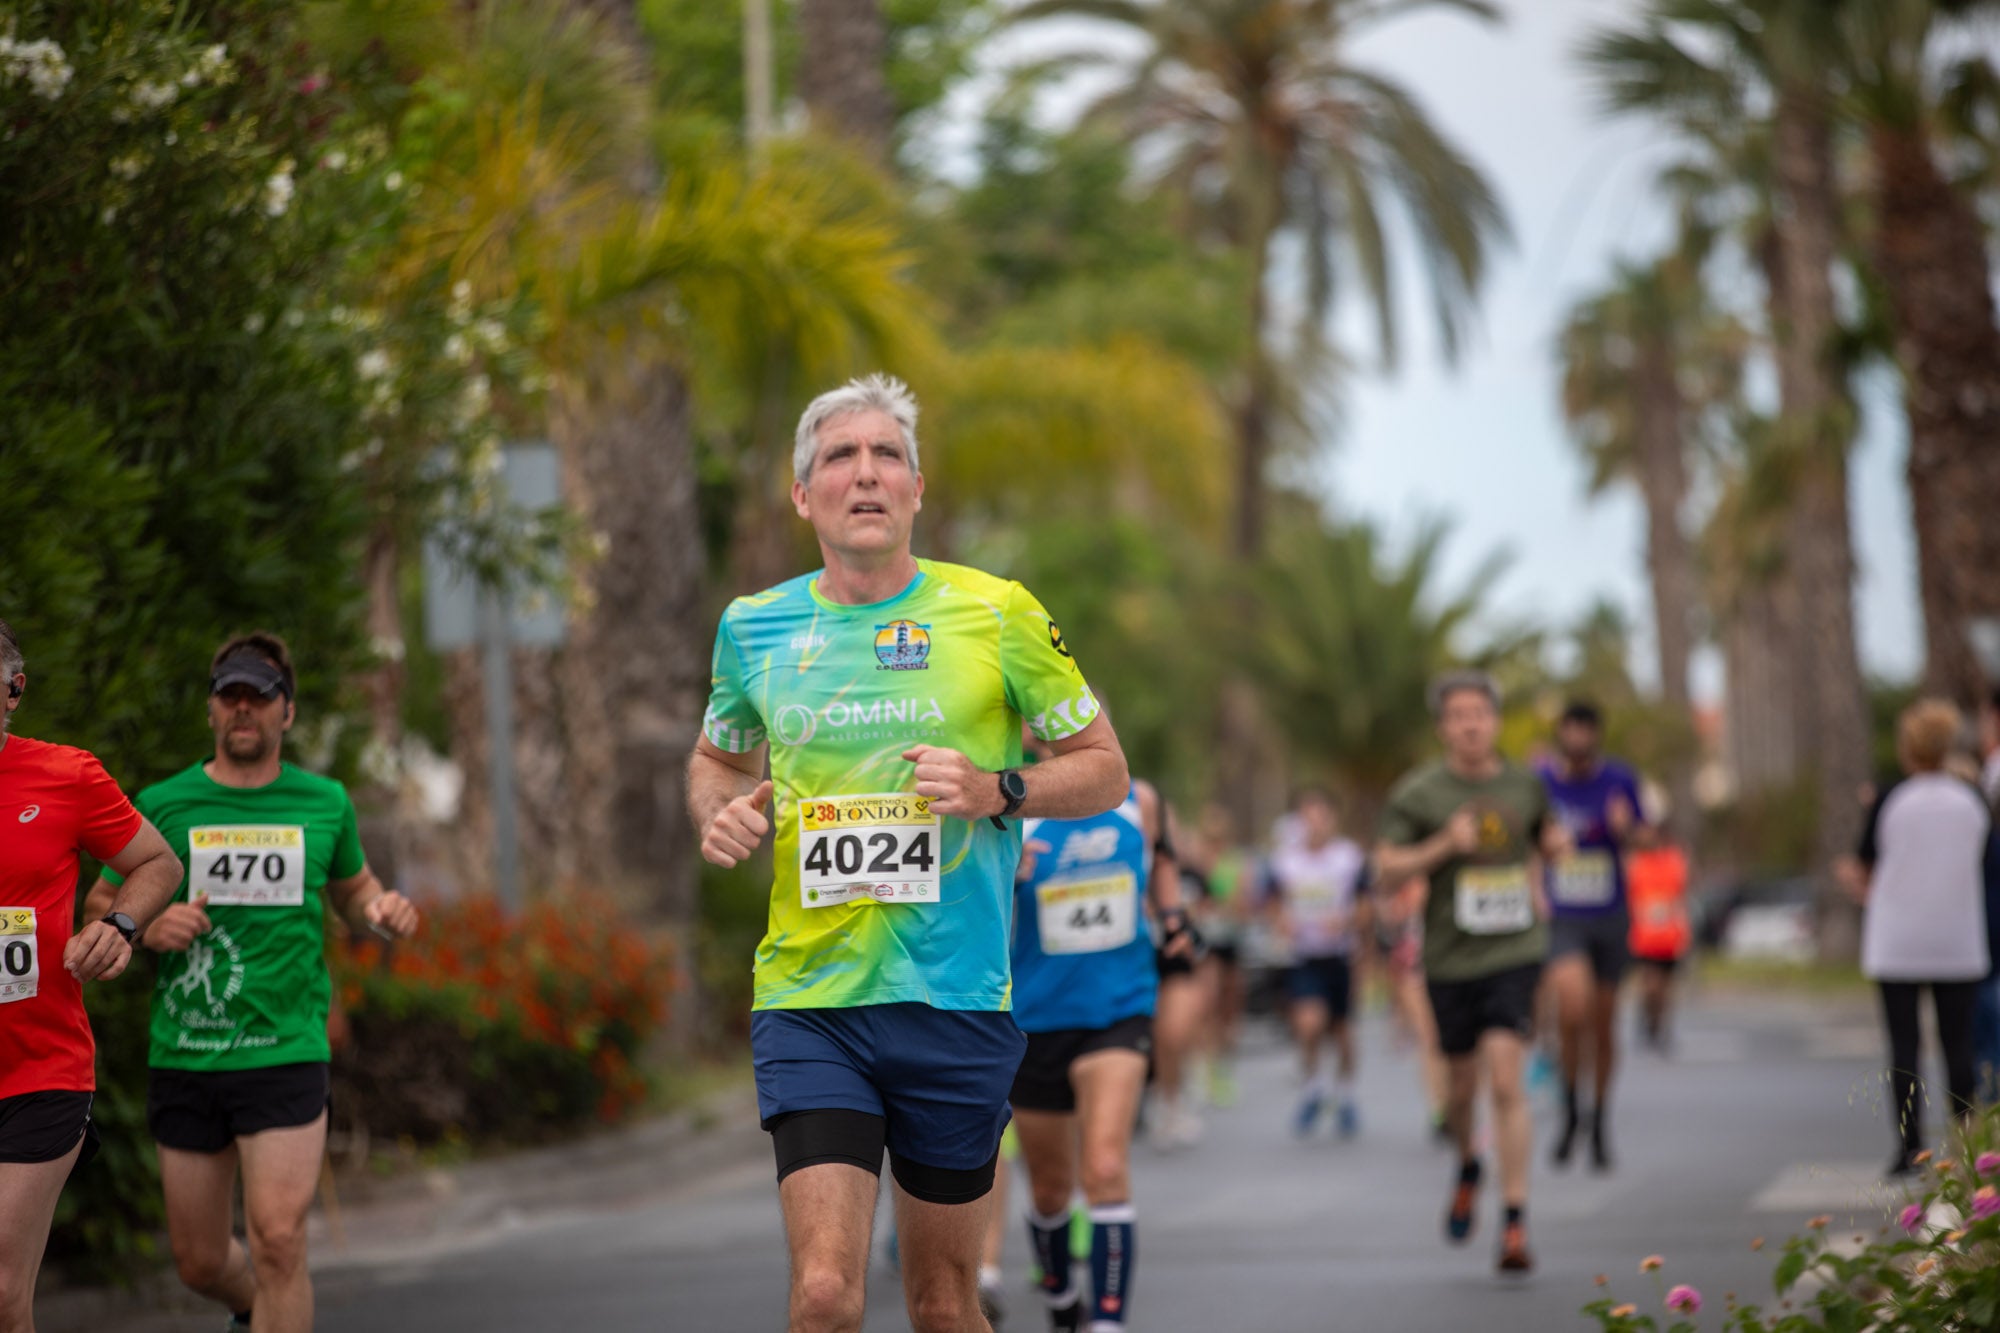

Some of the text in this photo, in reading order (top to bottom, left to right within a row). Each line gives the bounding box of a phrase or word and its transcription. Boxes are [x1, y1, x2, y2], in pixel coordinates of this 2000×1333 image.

[825, 698, 946, 727] OMNIA
[903, 728, 945, 738] LEGAL
[817, 804, 909, 822] 38 FONDO
[840, 800, 864, 808] GRAN
[866, 798, 901, 806] PREMIO
[804, 832, 934, 876] 4024
[208, 853, 285, 883] 470
[1067, 904, 1112, 928] 44
[0, 941, 32, 976] 0
